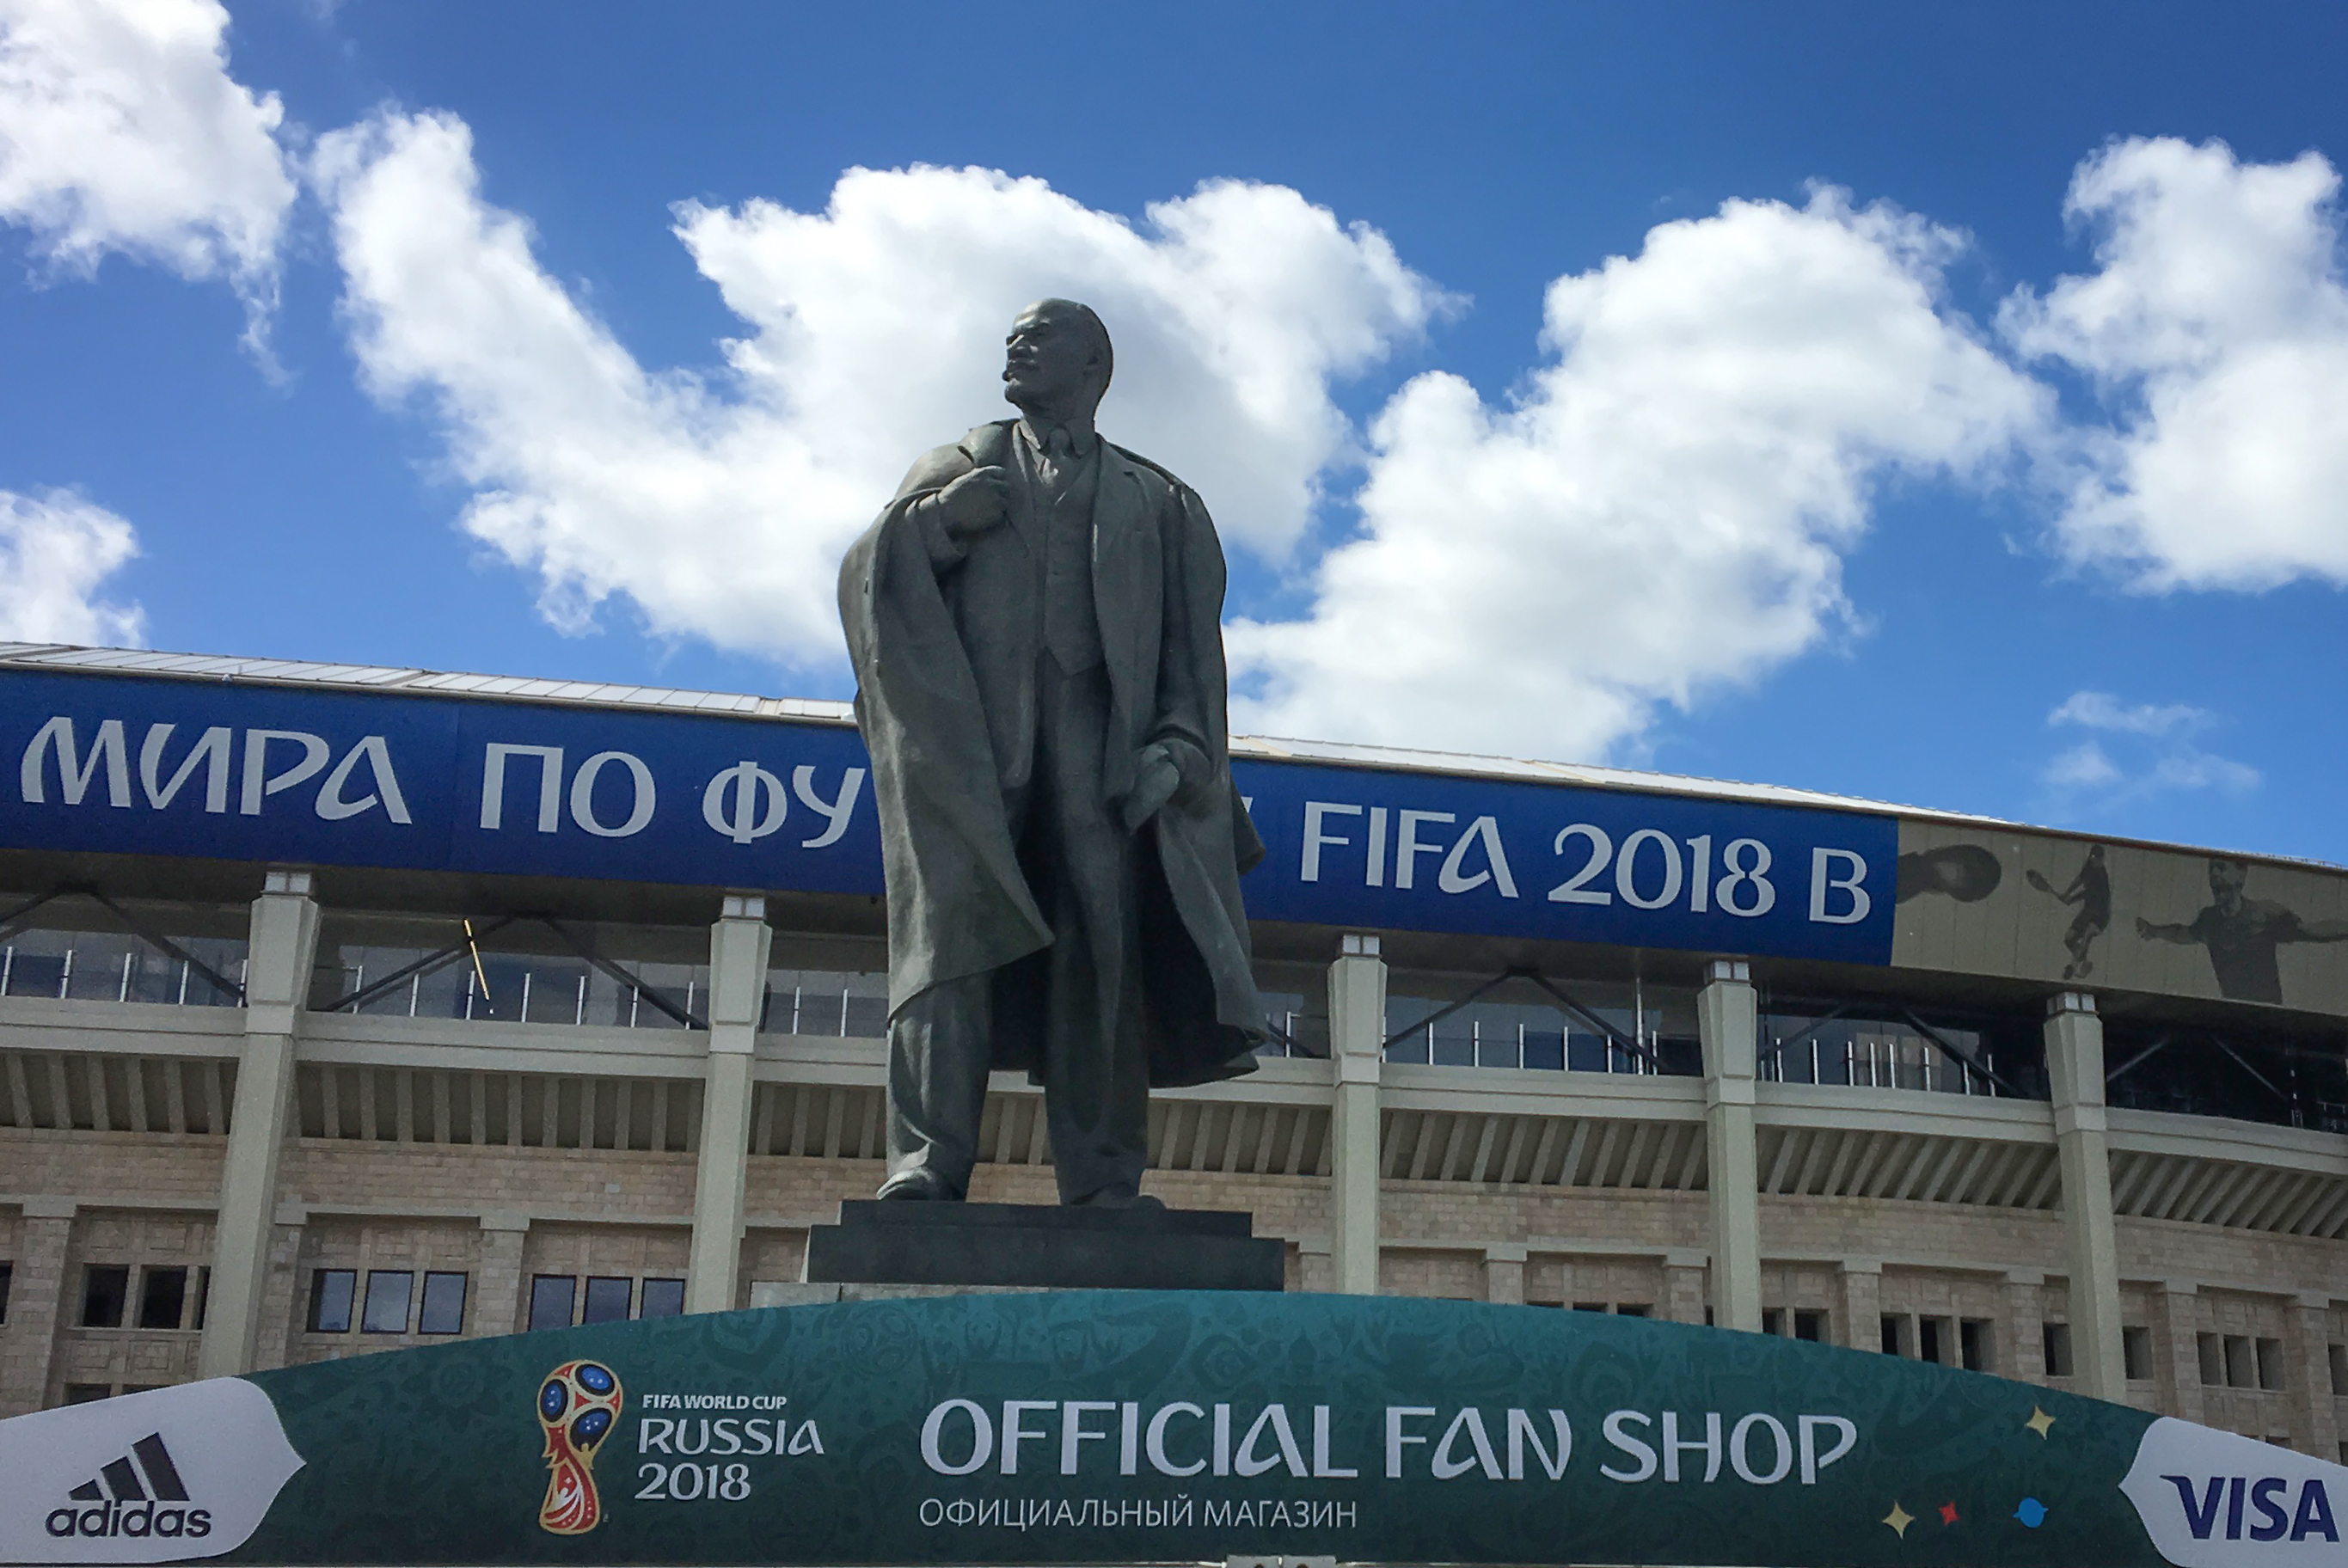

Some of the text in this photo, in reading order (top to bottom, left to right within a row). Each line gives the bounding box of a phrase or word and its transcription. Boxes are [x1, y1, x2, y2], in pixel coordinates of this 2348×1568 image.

[21, 716, 412, 824] МИРА
[480, 743, 656, 837] ПО
[1301, 800, 1519, 898] FIFA
[1548, 823, 1776, 916] 2018
[1809, 847, 1871, 924] В
[642, 1393, 788, 1410] FIFA WORLD CUP
[638, 1418, 825, 1455] RUSSIA
[920, 1399, 1857, 1485] OFFICIAL FAN SHOP
[635, 1462, 751, 1501] 2018
[45, 1500, 212, 1538] adidas
[919, 1493, 1357, 1532] ОФИЦИАЛЬНЫЙ МАГАЗИН
[2159, 1474, 2340, 1543] VISA
